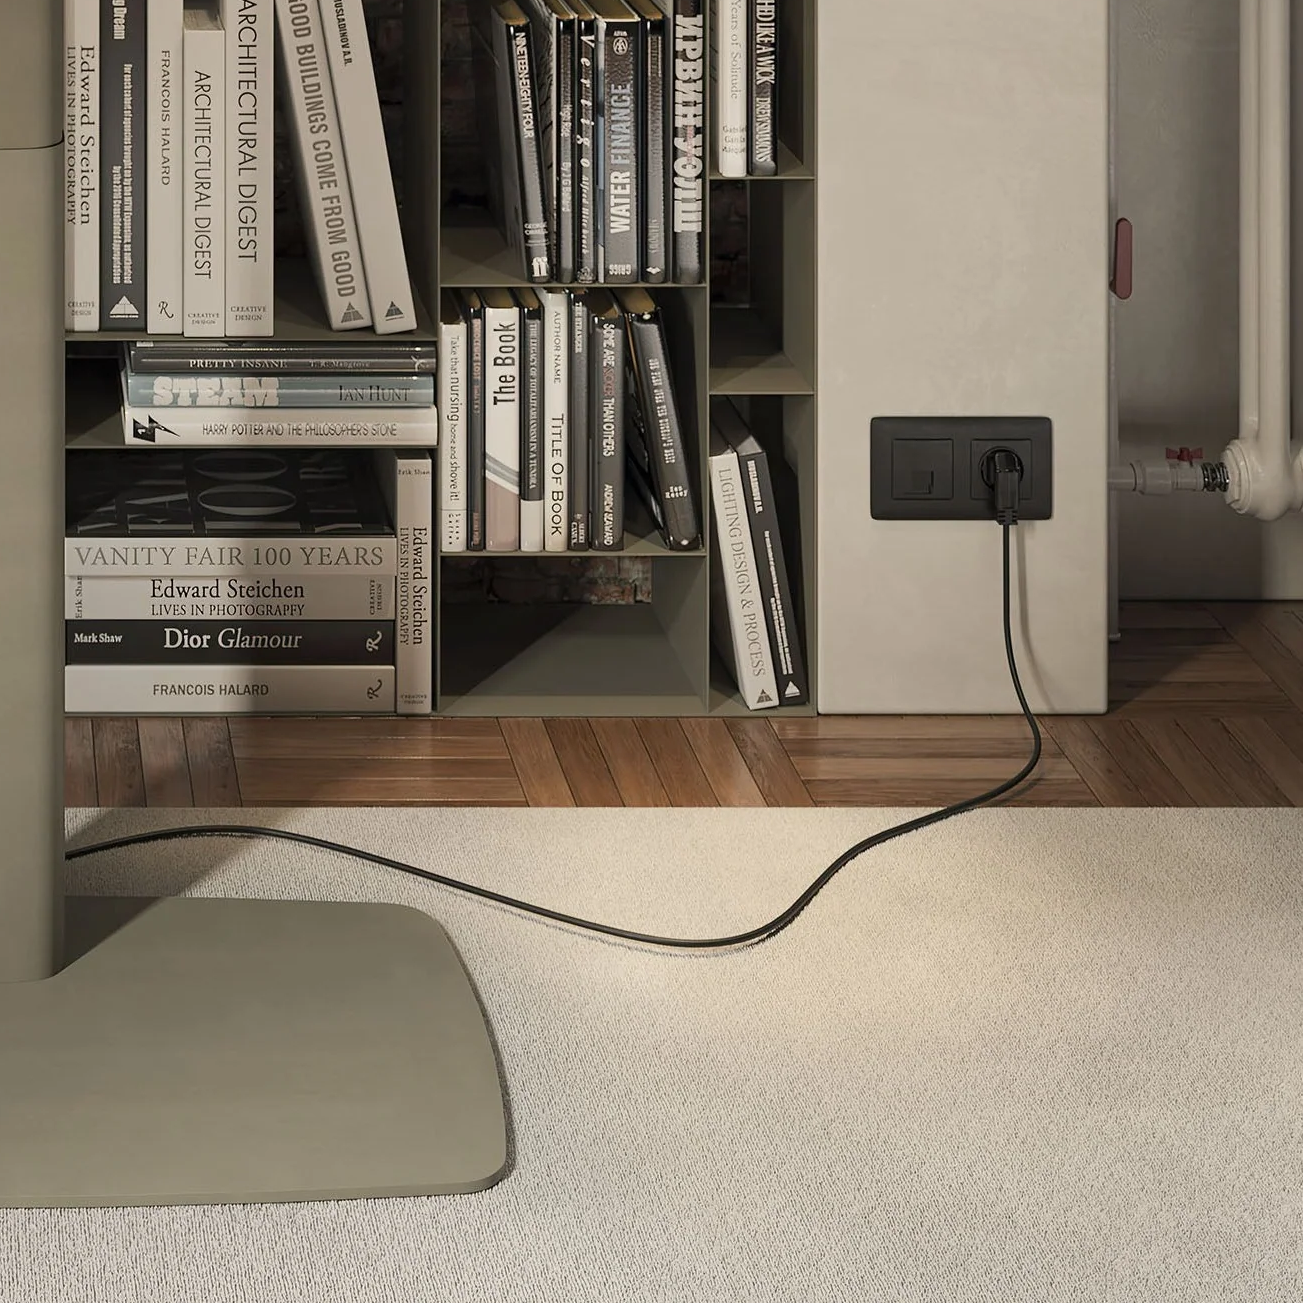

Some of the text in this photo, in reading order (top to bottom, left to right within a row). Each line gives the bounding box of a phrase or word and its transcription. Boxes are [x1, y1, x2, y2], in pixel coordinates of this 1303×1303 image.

[731, 35, 740, 48] of
[731, 52, 741, 99] Solitude
[610, 83, 632, 233] WATER FINANCE
[238, 184, 257, 262] DIGEST
[450, 336, 459, 353] Take
[242, 360, 287, 368] INSANE
[450, 357, 459, 374] that
[493, 371, 516, 405] The
[447, 377, 459, 421] nursing
[203, 424, 227, 435] HARRY
[232, 424, 264, 435] POTTER
[267, 424, 283, 435] AND
[287, 424, 302, 435] THE
[371, 424, 397, 435] STONE
[450, 462, 458, 484] shove
[450, 487, 458, 501] it!
[76, 548, 383, 566] VANITY FAIR 100 YEARS
[719, 469, 766, 676] LIGHTING DESIGN & PROCESS
[151, 579, 304, 598] Edward Steichen
[151, 605, 186, 615] LIVES
[192, 605, 204, 615] IN
[75, 633, 122, 643] Mark Shaw
[164, 628, 302, 648] Dior Glamour
[153, 685, 269, 695] FRANCOIS HALARD
